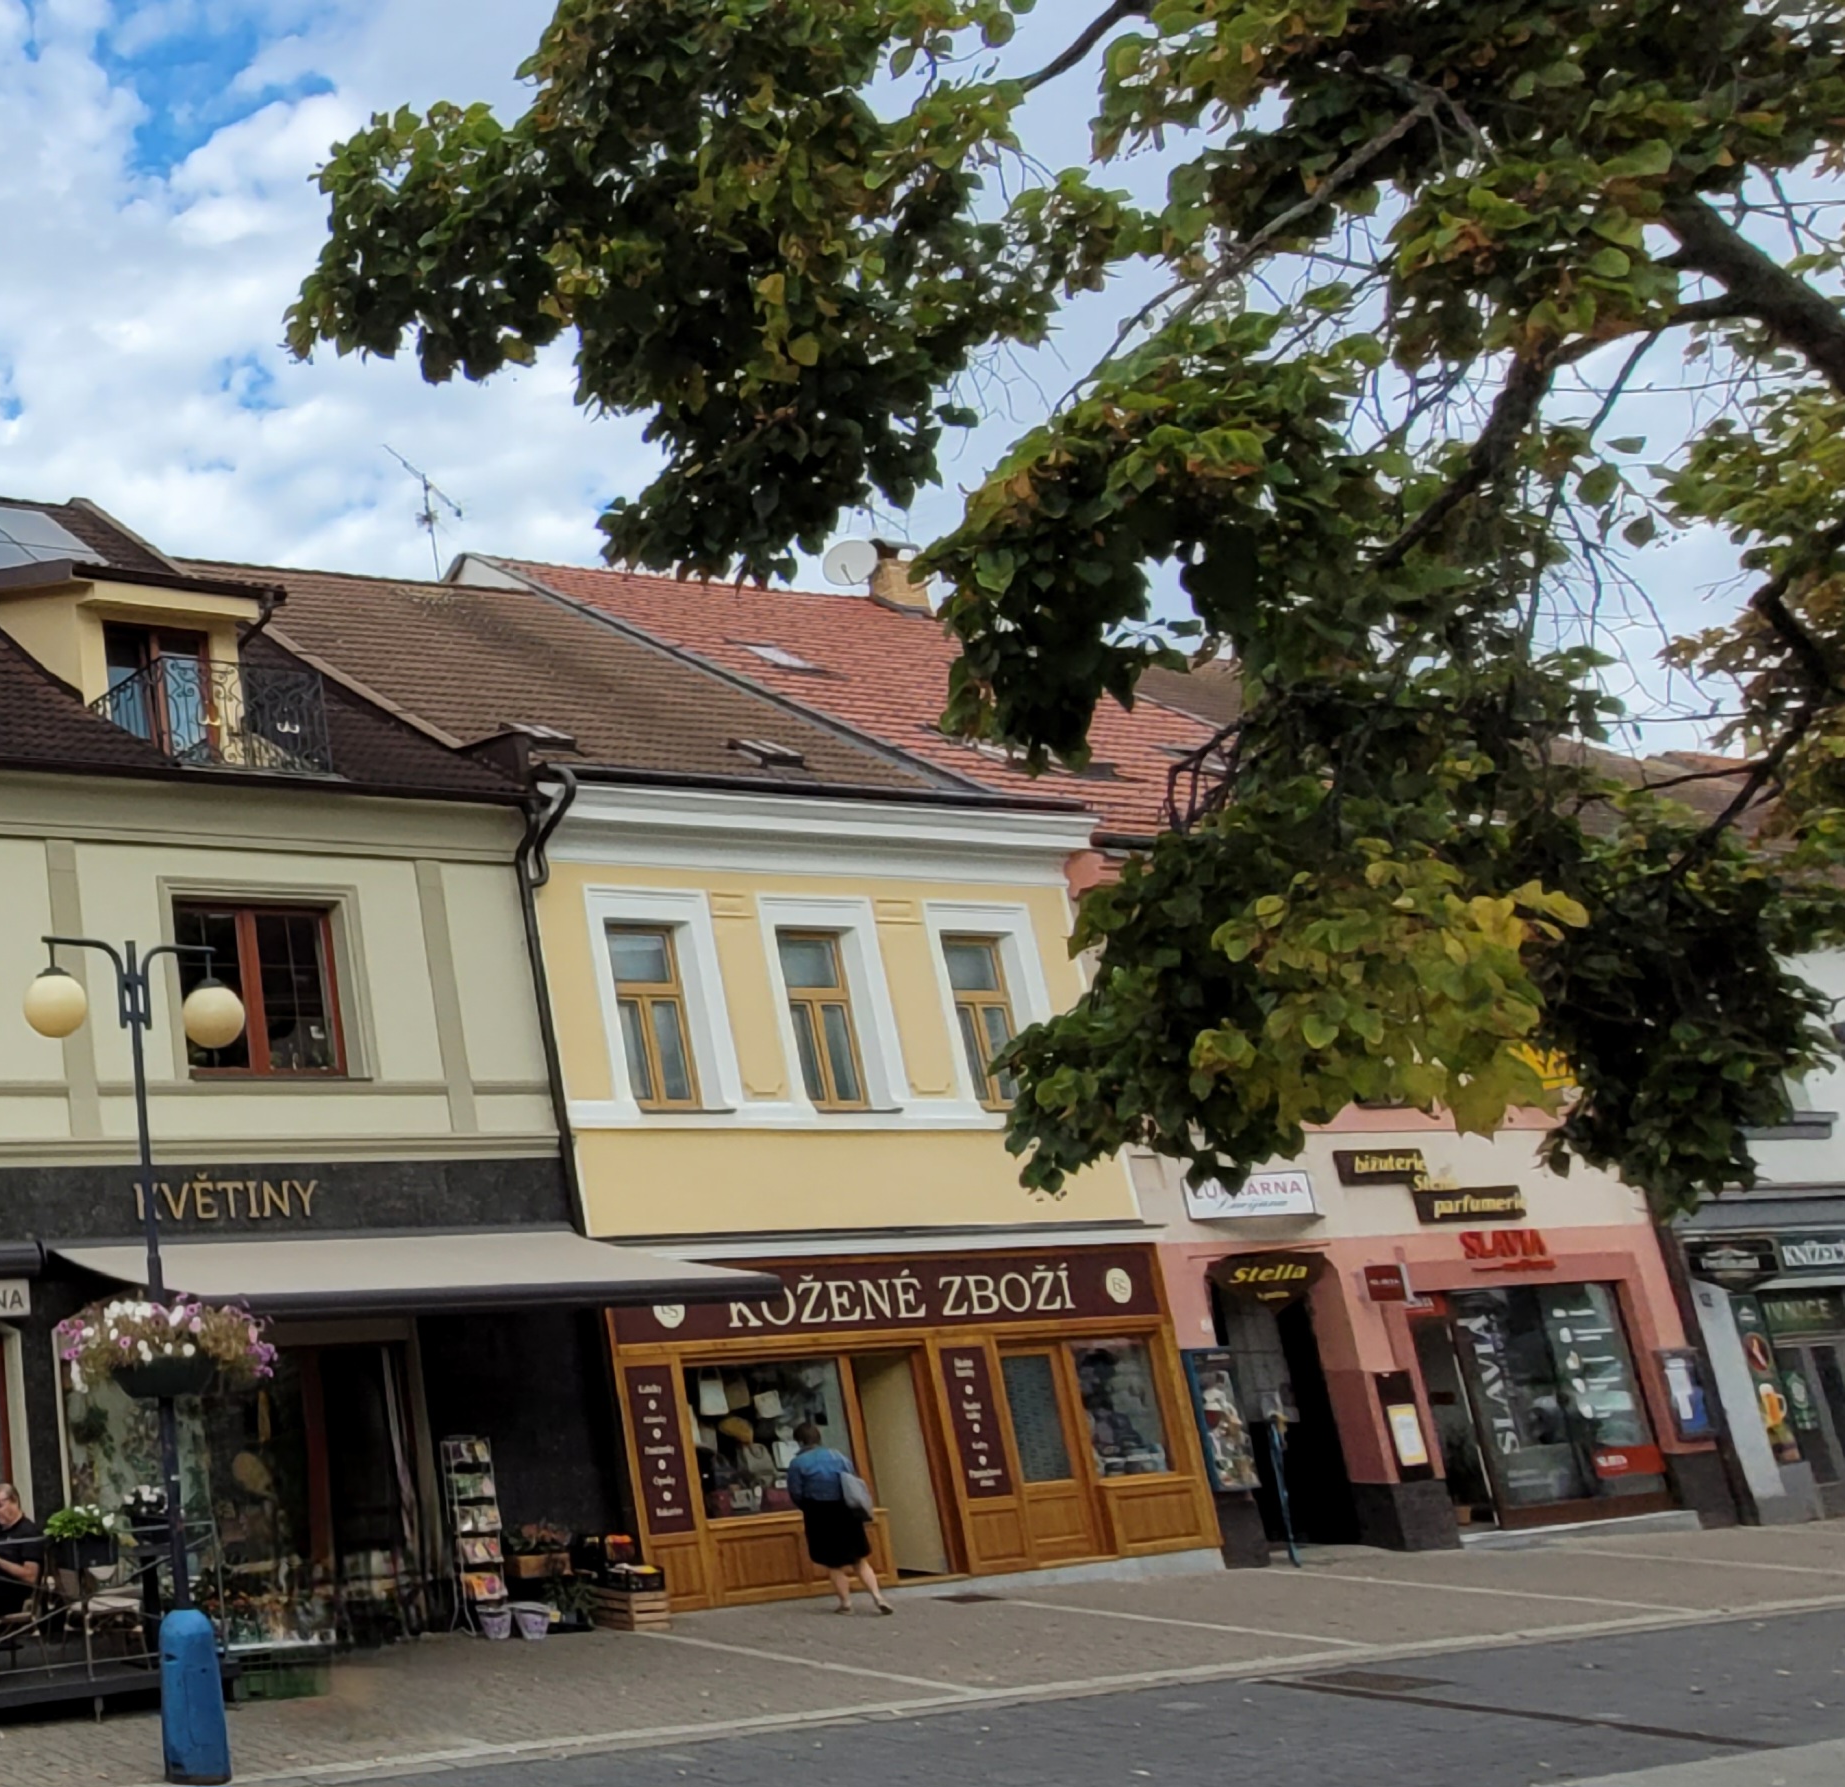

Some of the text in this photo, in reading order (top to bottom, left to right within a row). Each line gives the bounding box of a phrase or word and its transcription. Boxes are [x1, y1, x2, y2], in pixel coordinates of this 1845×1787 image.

[1228, 1263, 1308, 1284] Stella
[728, 1263, 1077, 1328] KOŽENÉ ZBOŽÍ
